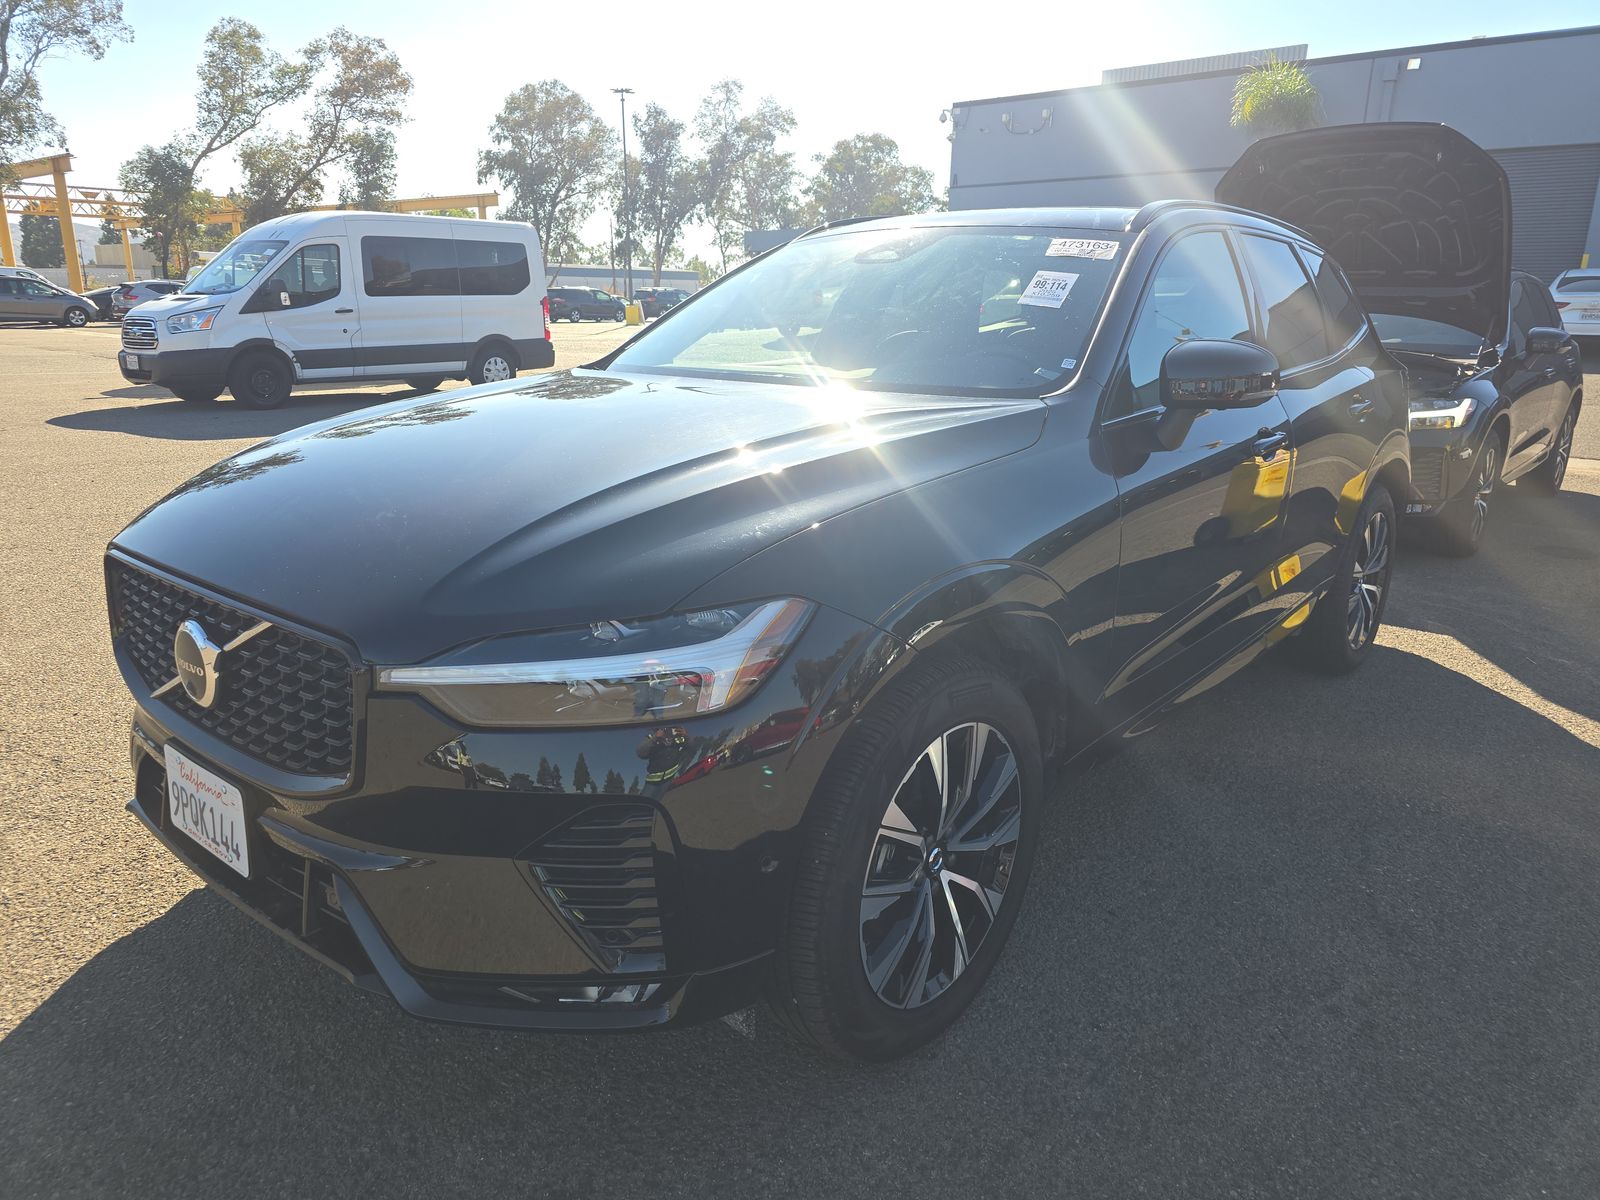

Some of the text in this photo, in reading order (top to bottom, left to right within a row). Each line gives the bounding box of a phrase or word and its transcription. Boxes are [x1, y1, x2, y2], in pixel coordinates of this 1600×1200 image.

[1032, 279, 1068, 291] 99:114
[179, 761, 223, 800] California
[171, 781, 241, 862] 9PQK144
